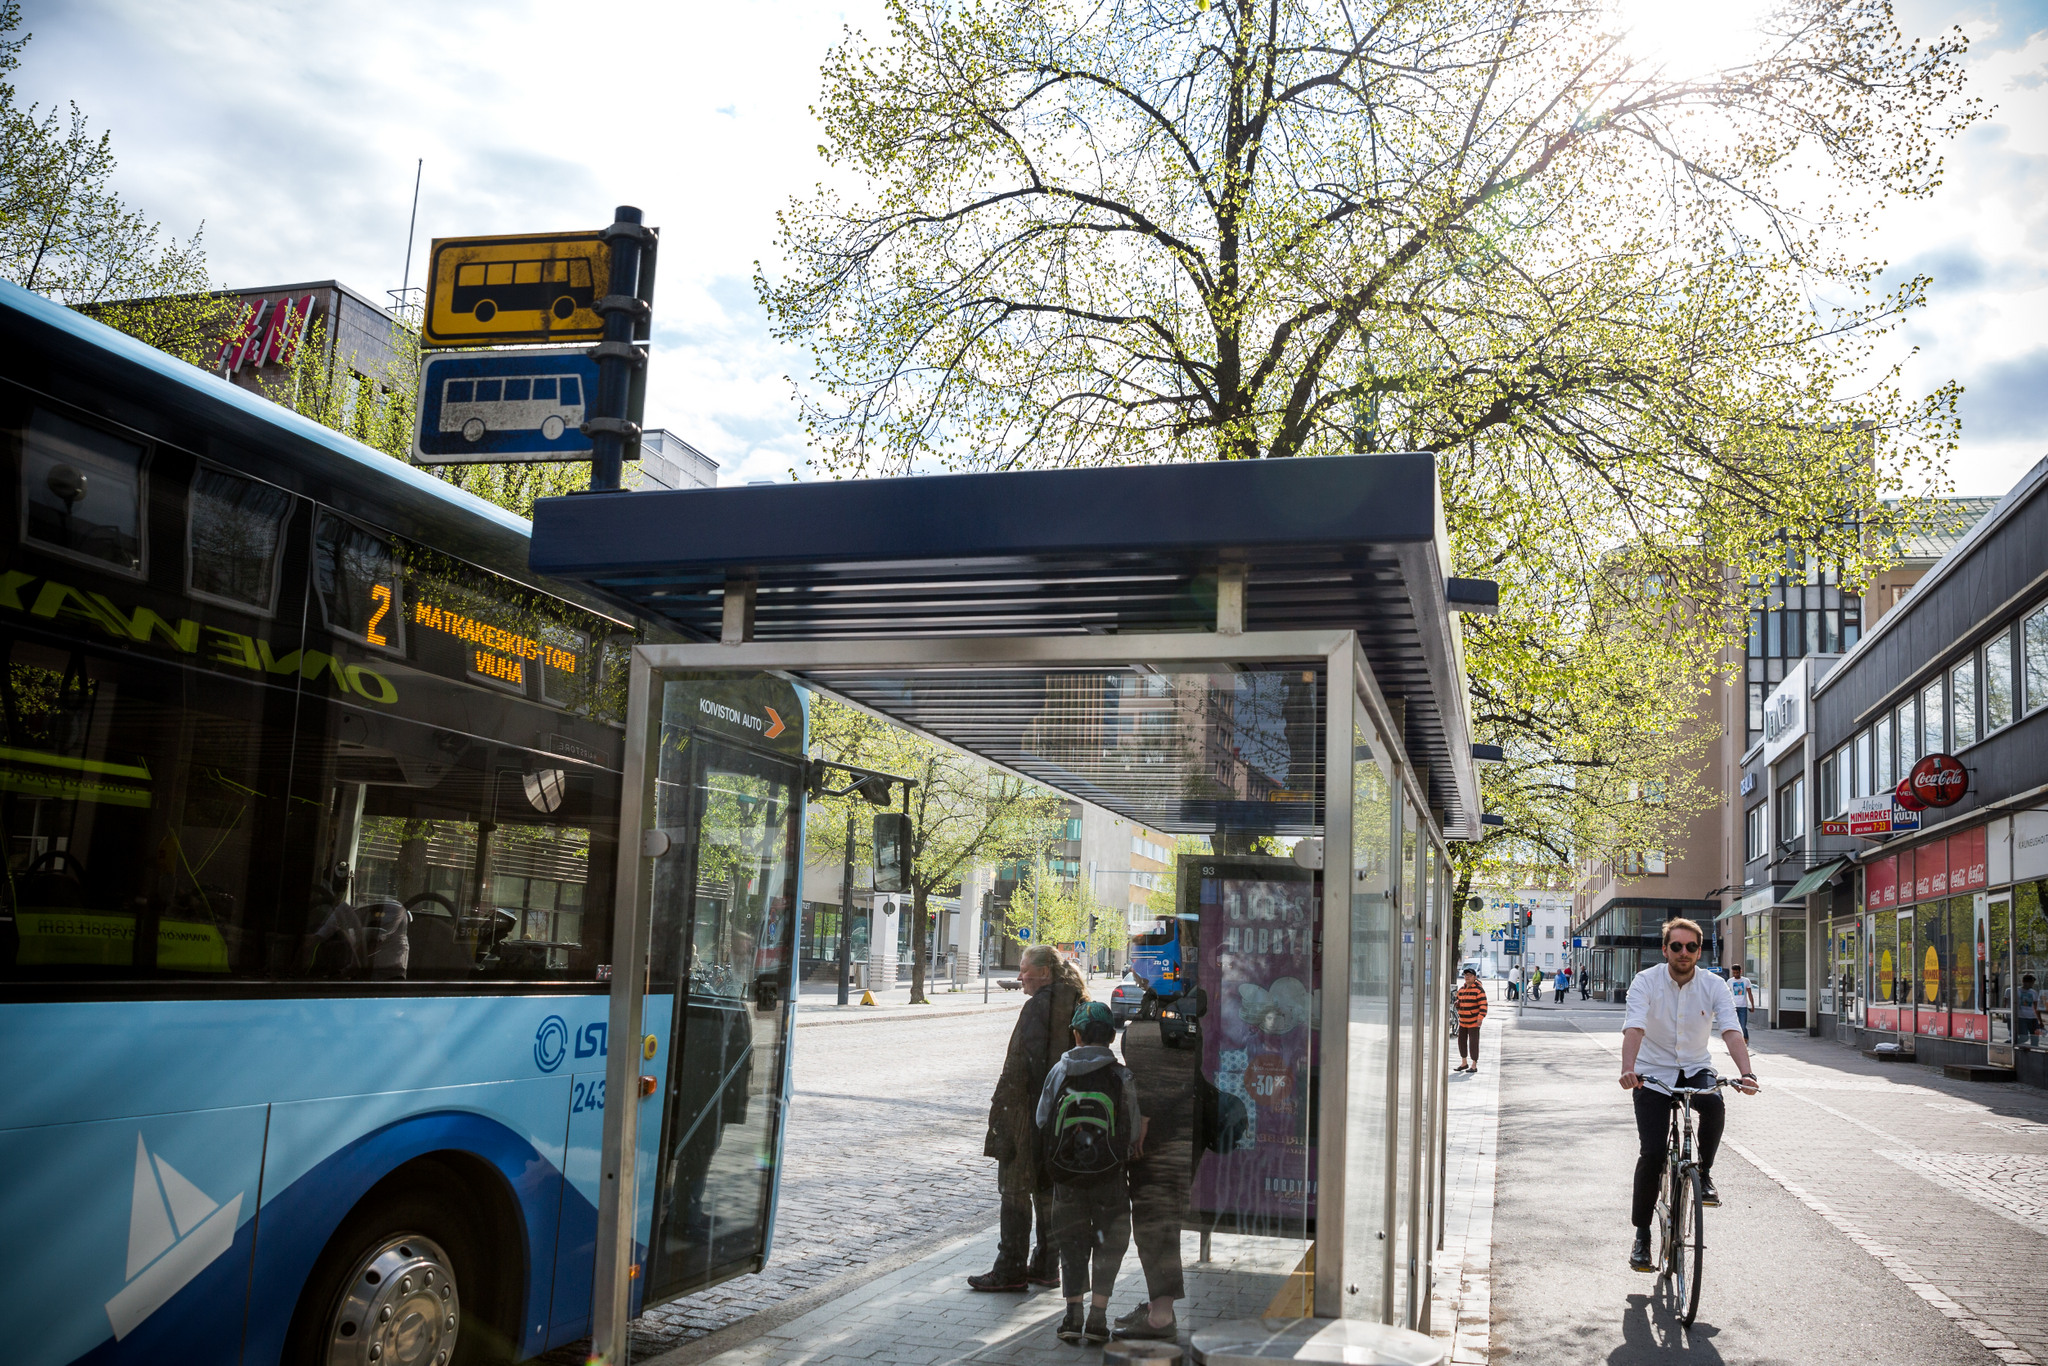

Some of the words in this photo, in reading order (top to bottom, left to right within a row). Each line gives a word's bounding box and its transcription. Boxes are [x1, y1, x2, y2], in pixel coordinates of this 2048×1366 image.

[367, 584, 391, 646] 2
[415, 602, 576, 674] MATKAKESKUS-TORI
[475, 651, 522, 684] VIUHA
[700, 698, 740, 724] KOIVISTON
[742, 713, 762, 731] AUTO
[1914, 769, 1962, 788] Coca-Cola
[1850, 809, 1891, 822] MINIMARKET
[1893, 811, 1918, 823] KULTA
[1202, 866, 1215, 876] 93
[572, 1080, 606, 1113] 243
[1251, 1074, 1286, 1097] -30%
